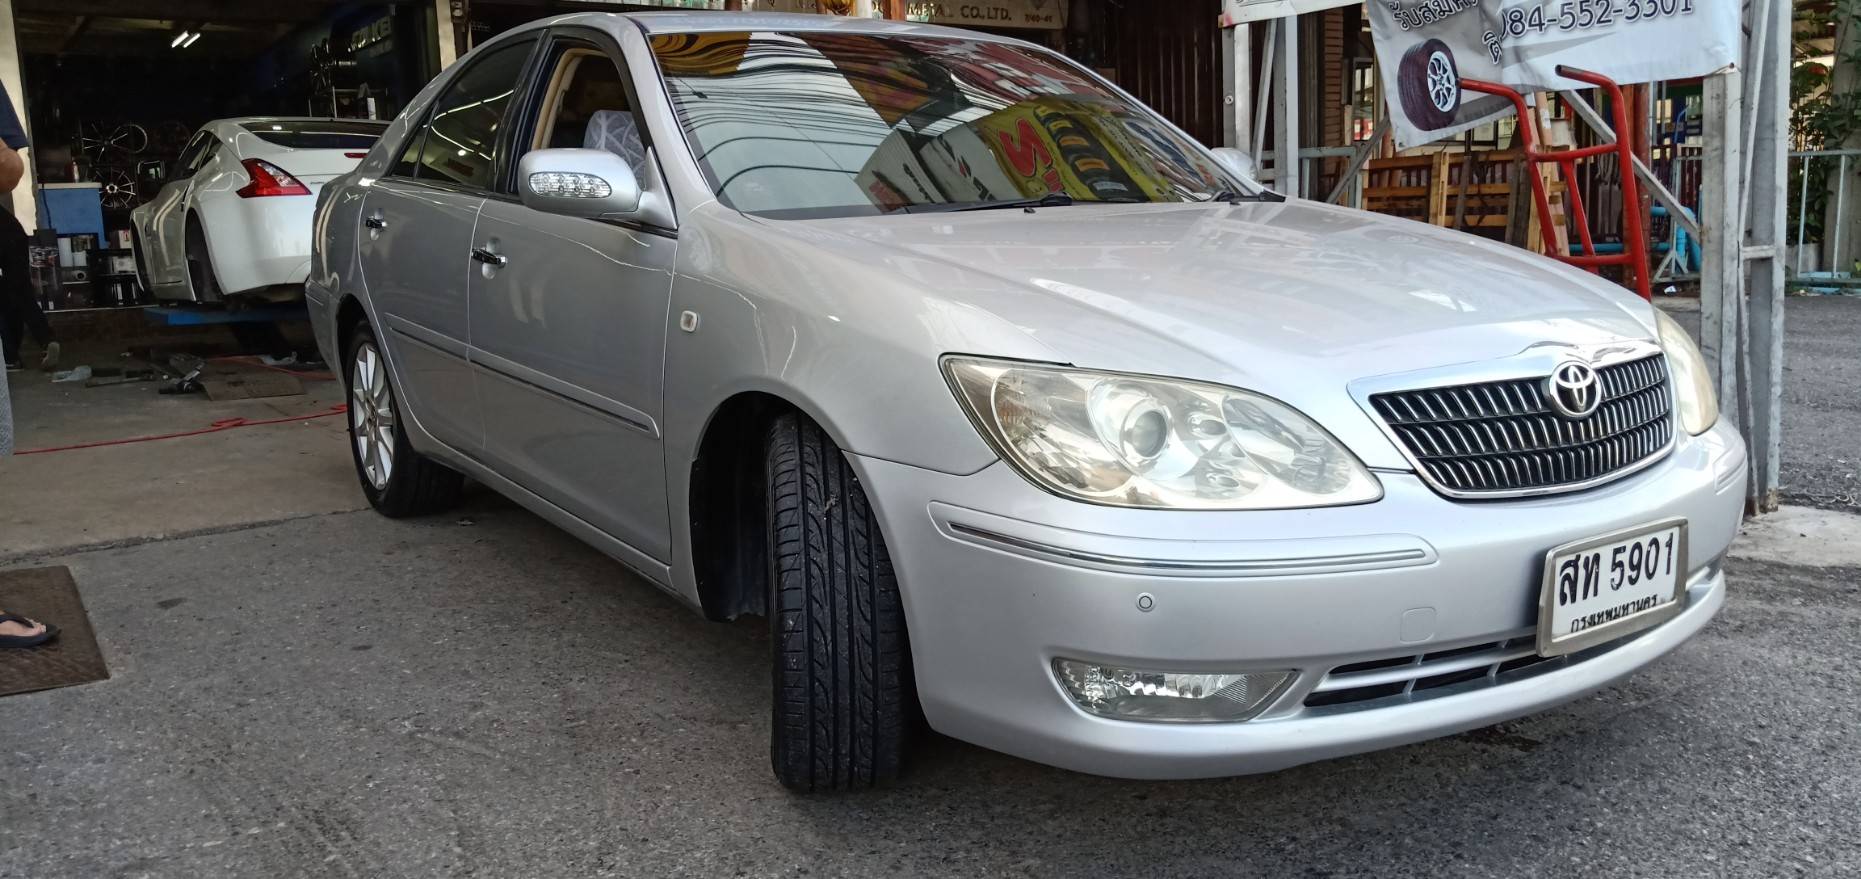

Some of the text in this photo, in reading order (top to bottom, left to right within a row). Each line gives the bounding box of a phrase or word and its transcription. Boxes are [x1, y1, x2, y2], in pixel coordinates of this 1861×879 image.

[1559, 532, 1674, 607] สท 5901
[1571, 594, 1657, 632] กรงเทพมหานคร
